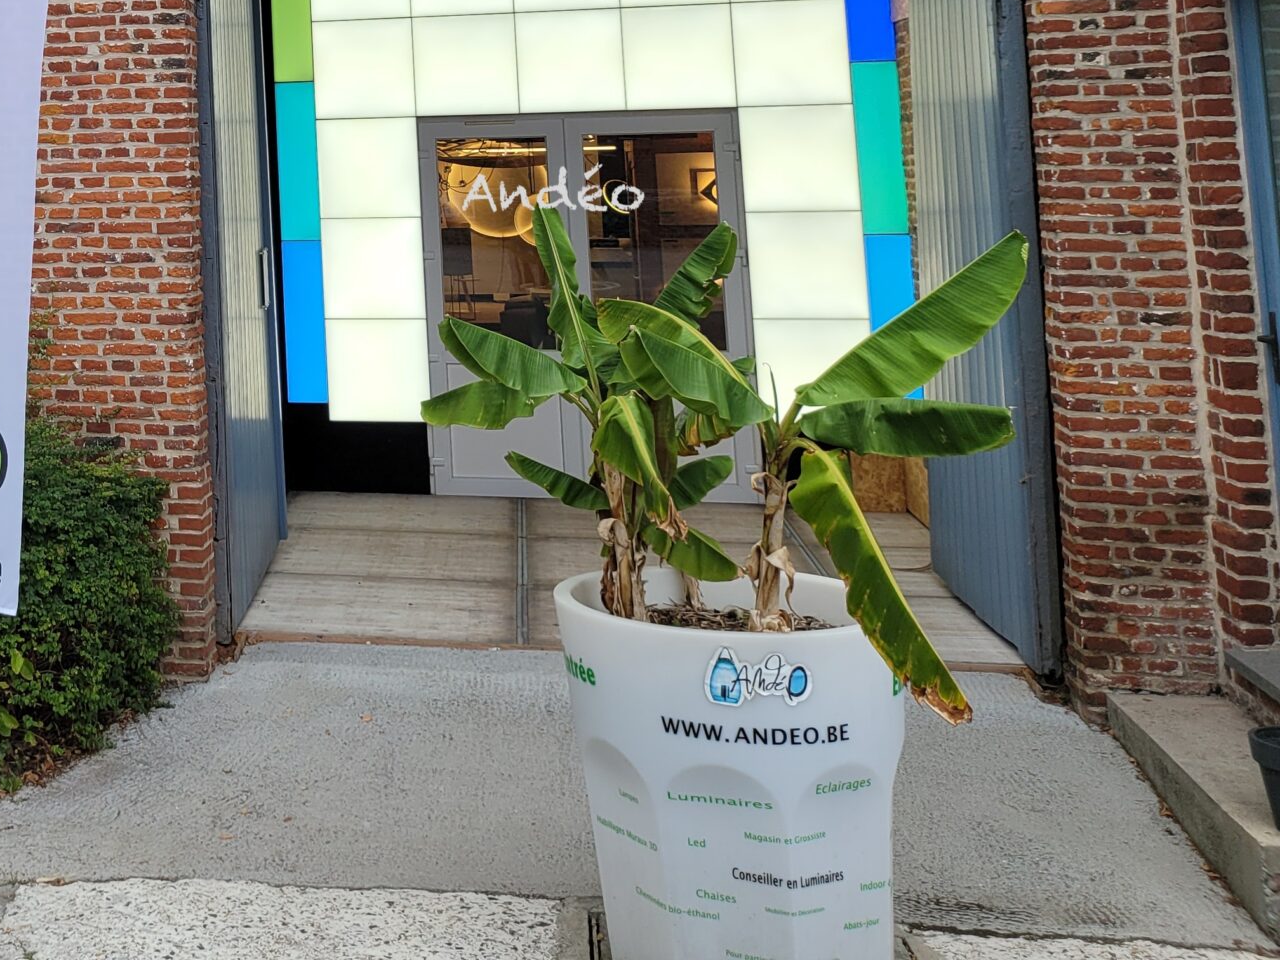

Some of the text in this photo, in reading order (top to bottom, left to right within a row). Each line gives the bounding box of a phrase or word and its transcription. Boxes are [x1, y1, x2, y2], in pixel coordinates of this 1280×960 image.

[462, 163, 645, 213] Andéo
[661, 715, 850, 746] WWW.ANDEO.BE
[815, 777, 872, 795] Eclairages
[667, 791, 774, 810] Luminaires
[687, 837, 707, 848] Led
[743, 831, 781, 844] Magasin
[794, 831, 827, 844] Grossiste
[732, 867, 844, 889] Conseiller en Luminaires
[860, 881, 886, 892] Indoor
[695, 888, 737, 904] Chaises
[668, 905, 721, 921] bio-éthanol
[843, 917, 880, 931] Abats-jour
